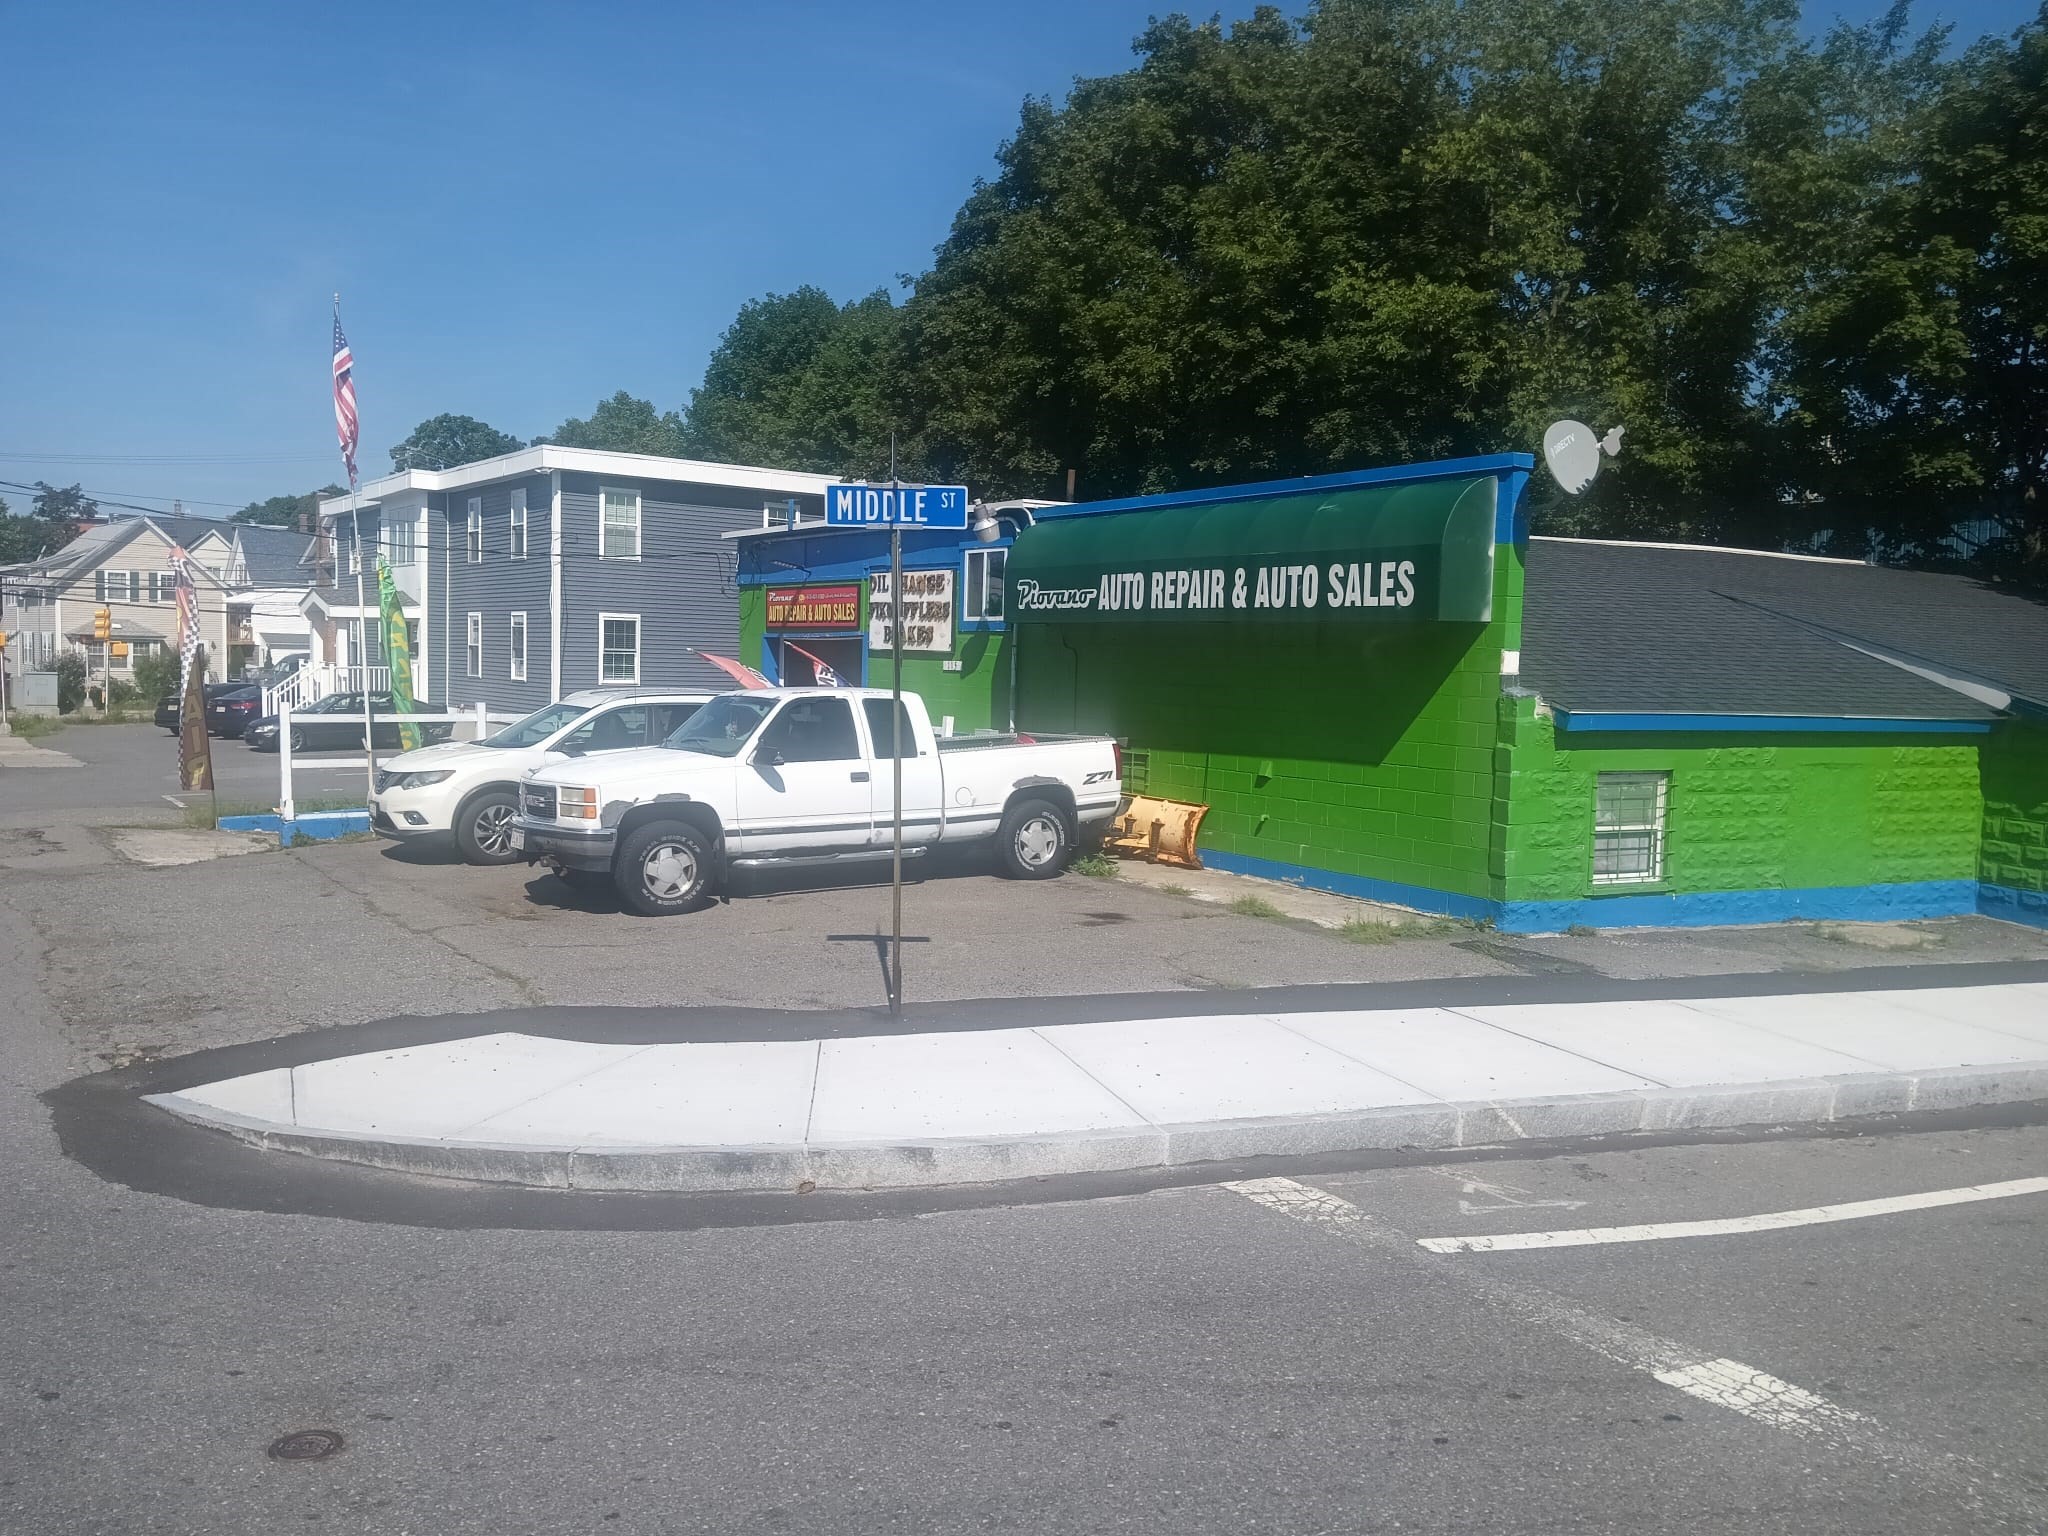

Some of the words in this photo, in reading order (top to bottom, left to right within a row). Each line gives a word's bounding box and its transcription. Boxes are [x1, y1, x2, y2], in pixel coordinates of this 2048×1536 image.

[837, 490, 928, 522] MIDDLE
[941, 492, 956, 508] ST
[1017, 579, 1097, 610] Piovano
[1098, 572, 1145, 611] AUTO
[1151, 568, 1225, 609] REPAIR
[1231, 567, 1249, 608] &
[1254, 564, 1319, 608] AUTO
[1327, 560, 1415, 608] SALES
[769, 605, 783, 622] AUTO
[784, 605, 807, 622] REPAIR
[808, 605, 813, 621] &
[815, 603, 831, 621] AUTO
[833, 603, 855, 621] SALES
[1082, 770, 1113, 786] Z71
